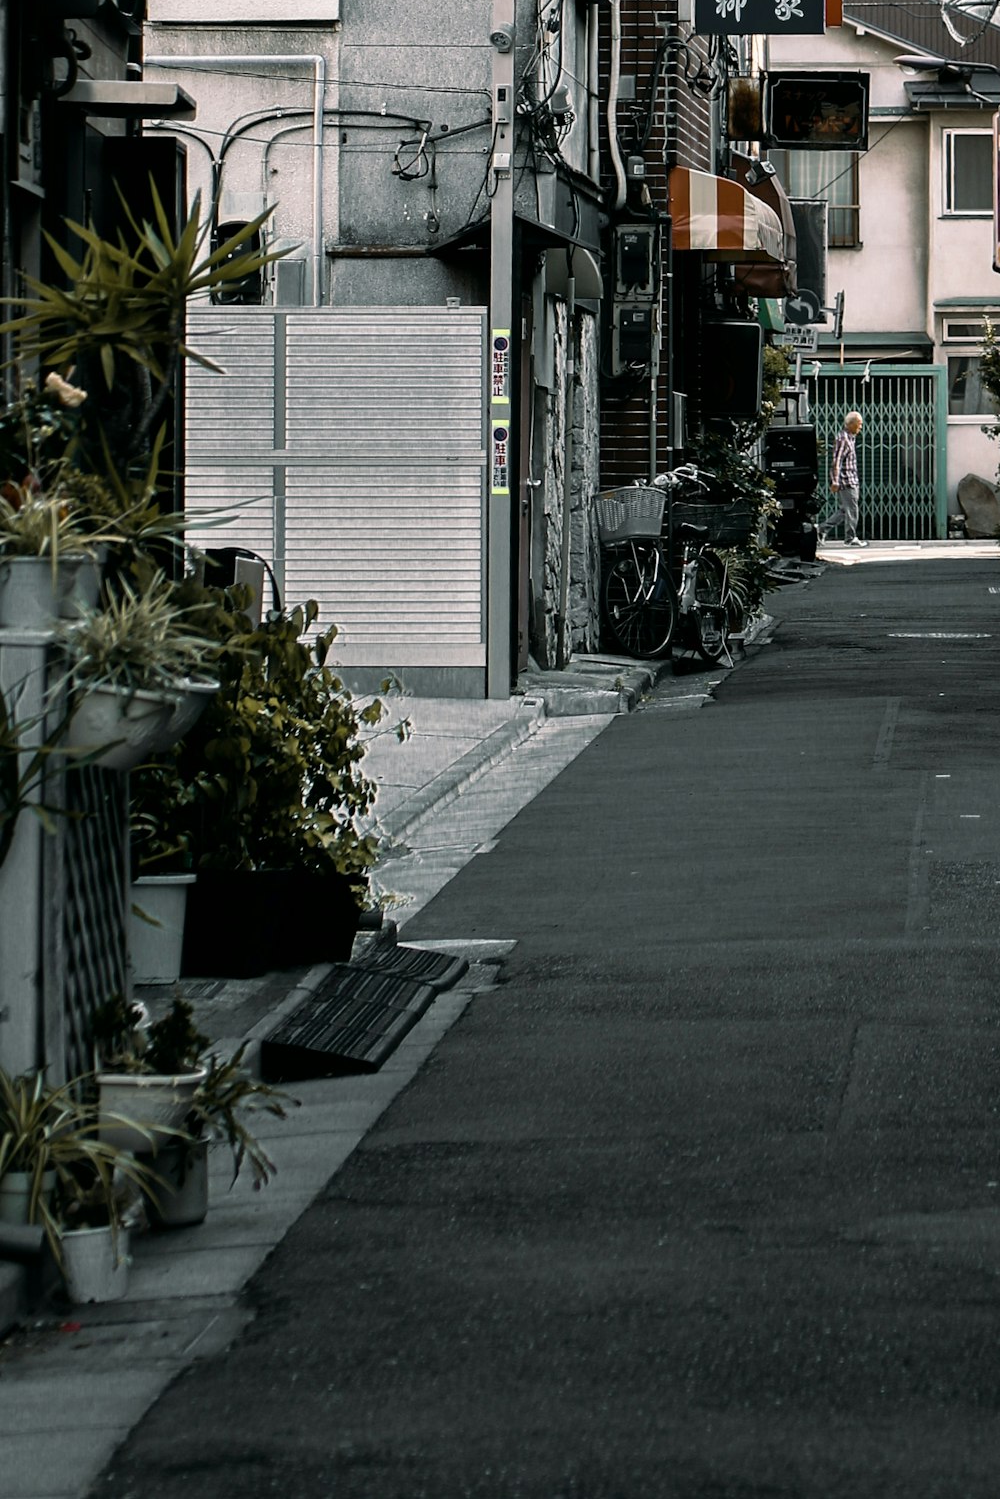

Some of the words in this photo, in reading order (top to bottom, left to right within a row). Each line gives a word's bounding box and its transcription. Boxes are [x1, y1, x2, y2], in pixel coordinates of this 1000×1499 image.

[782, 89, 828, 101] スナック
[493, 352, 504, 397] 駐車禁止
[495, 443, 506, 466] 駐車
